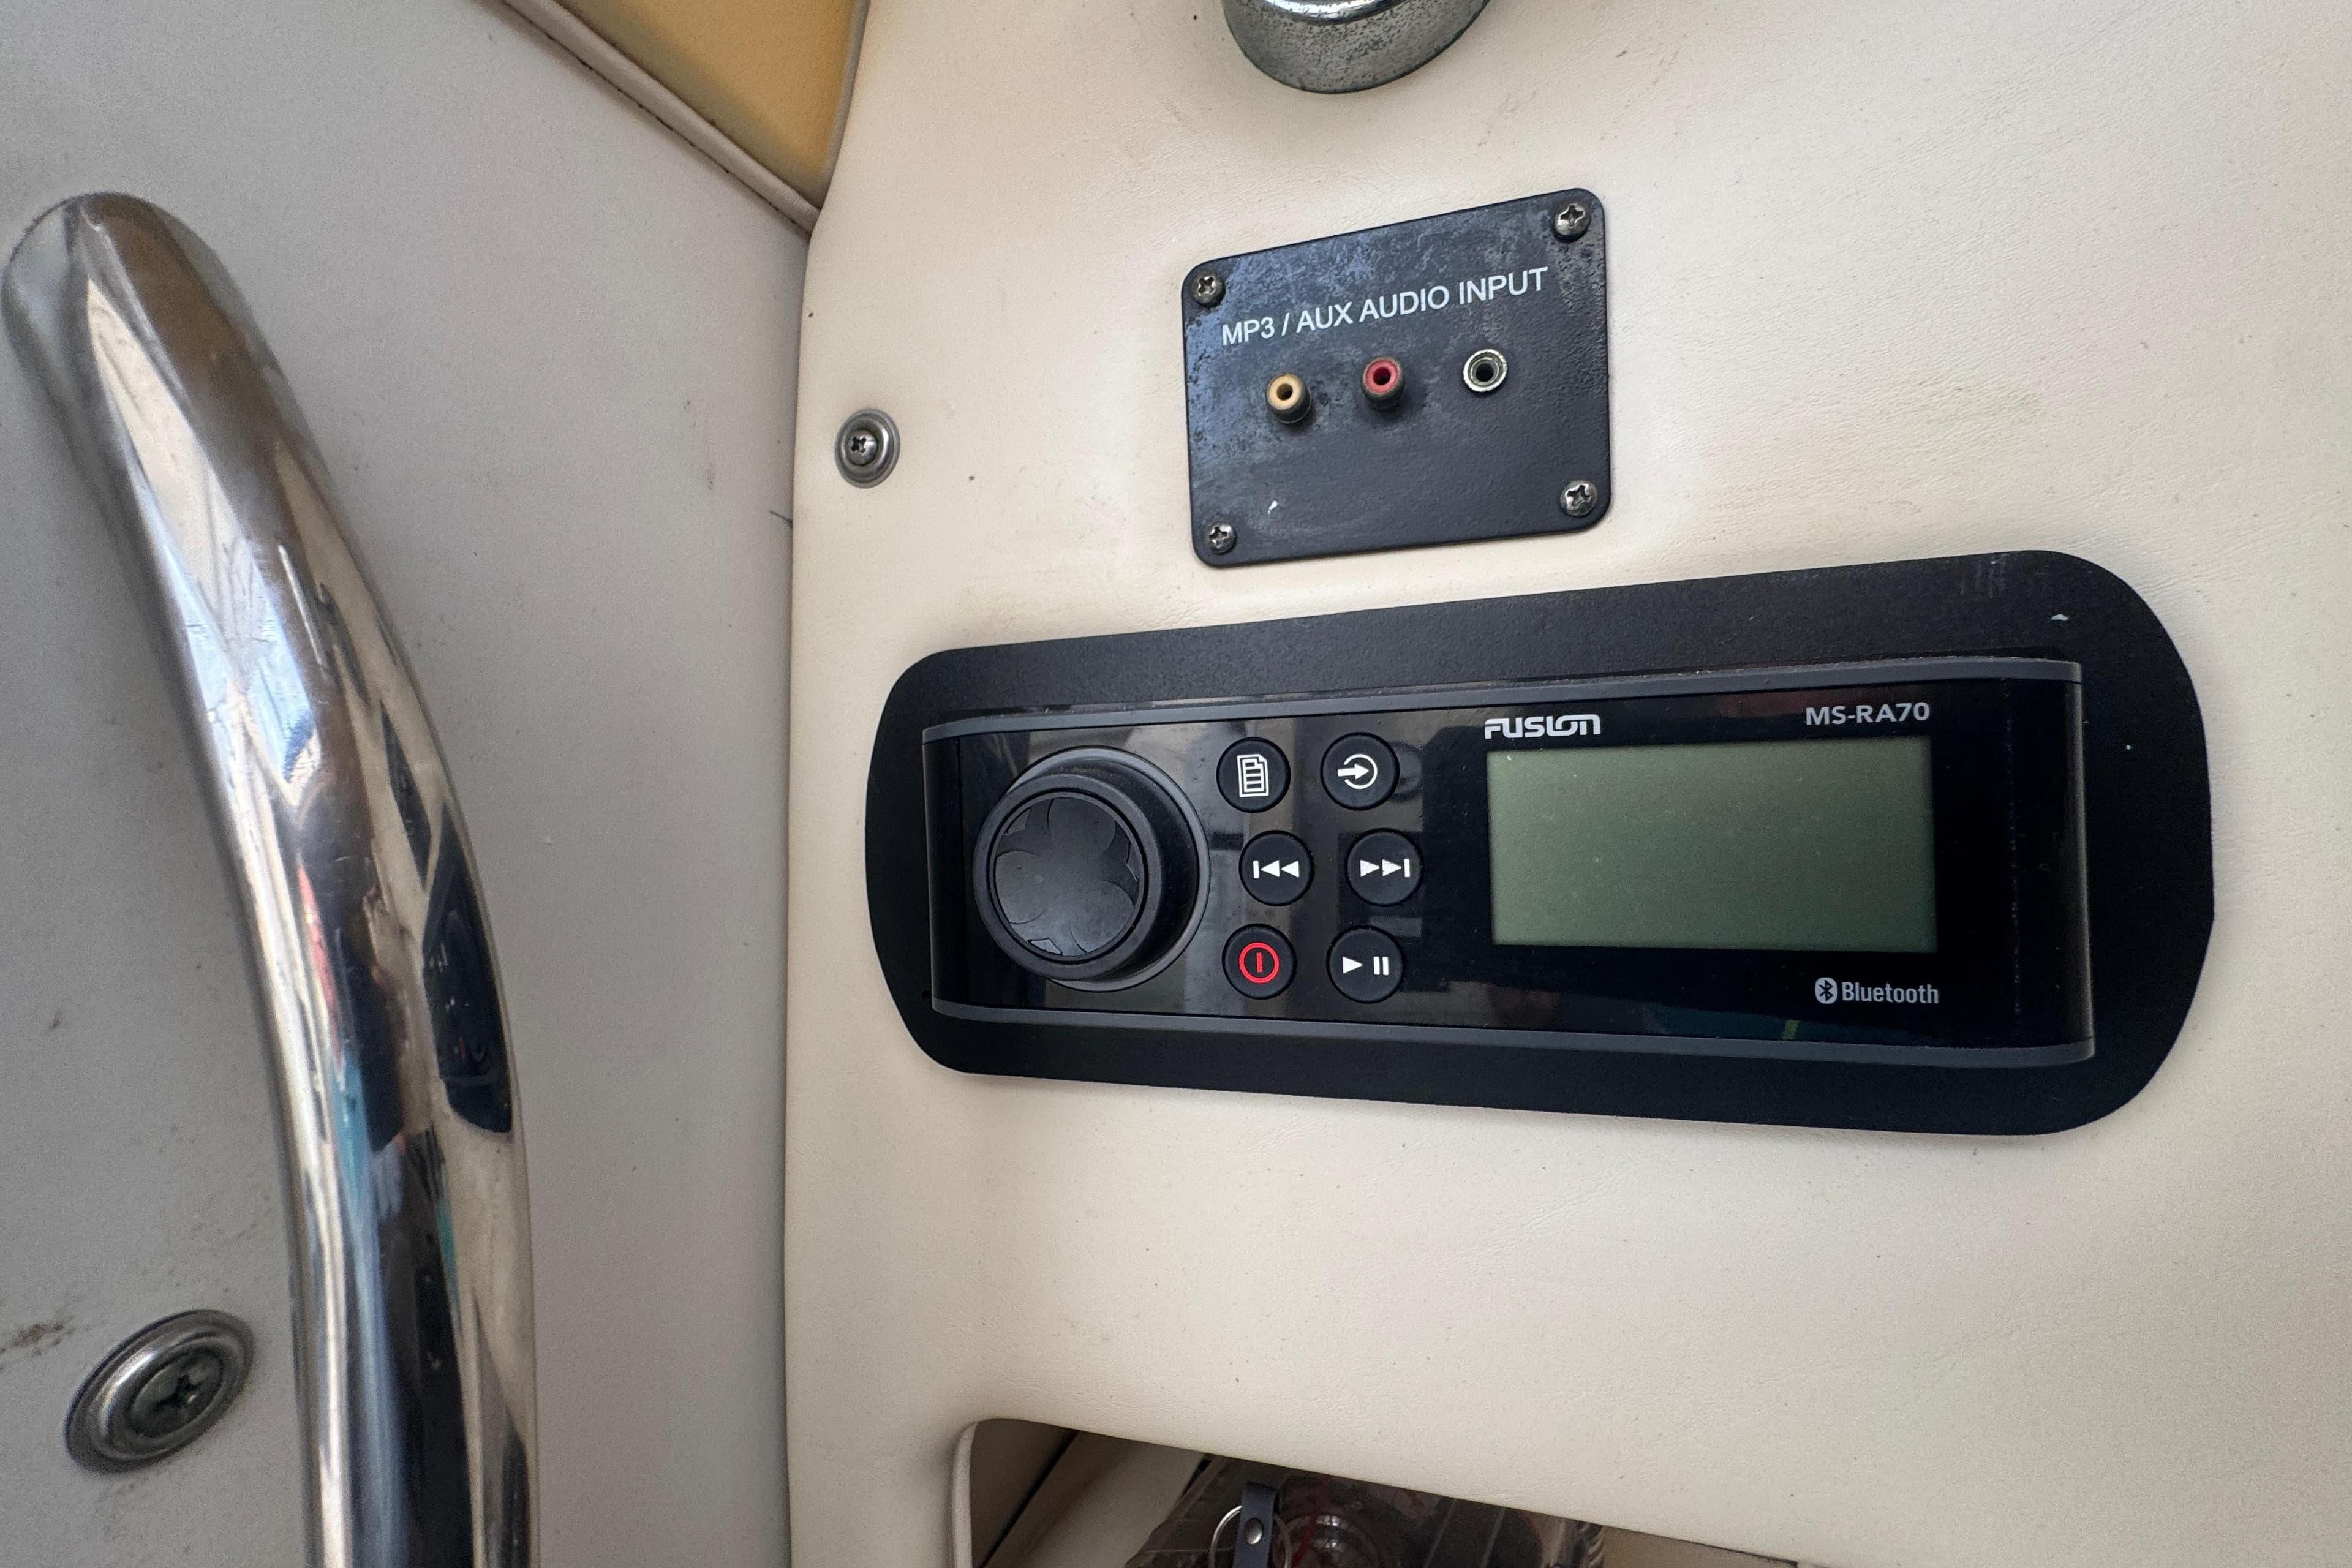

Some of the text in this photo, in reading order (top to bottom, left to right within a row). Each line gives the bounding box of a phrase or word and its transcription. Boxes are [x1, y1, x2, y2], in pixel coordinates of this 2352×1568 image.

[1222, 266, 1549, 345] MP3 / AUX AUDIO INPUT
[1805, 701, 1931, 726] MS-RA70
[1484, 714, 1601, 740] FUSION
[1842, 981, 1939, 1004] Bluetooth
